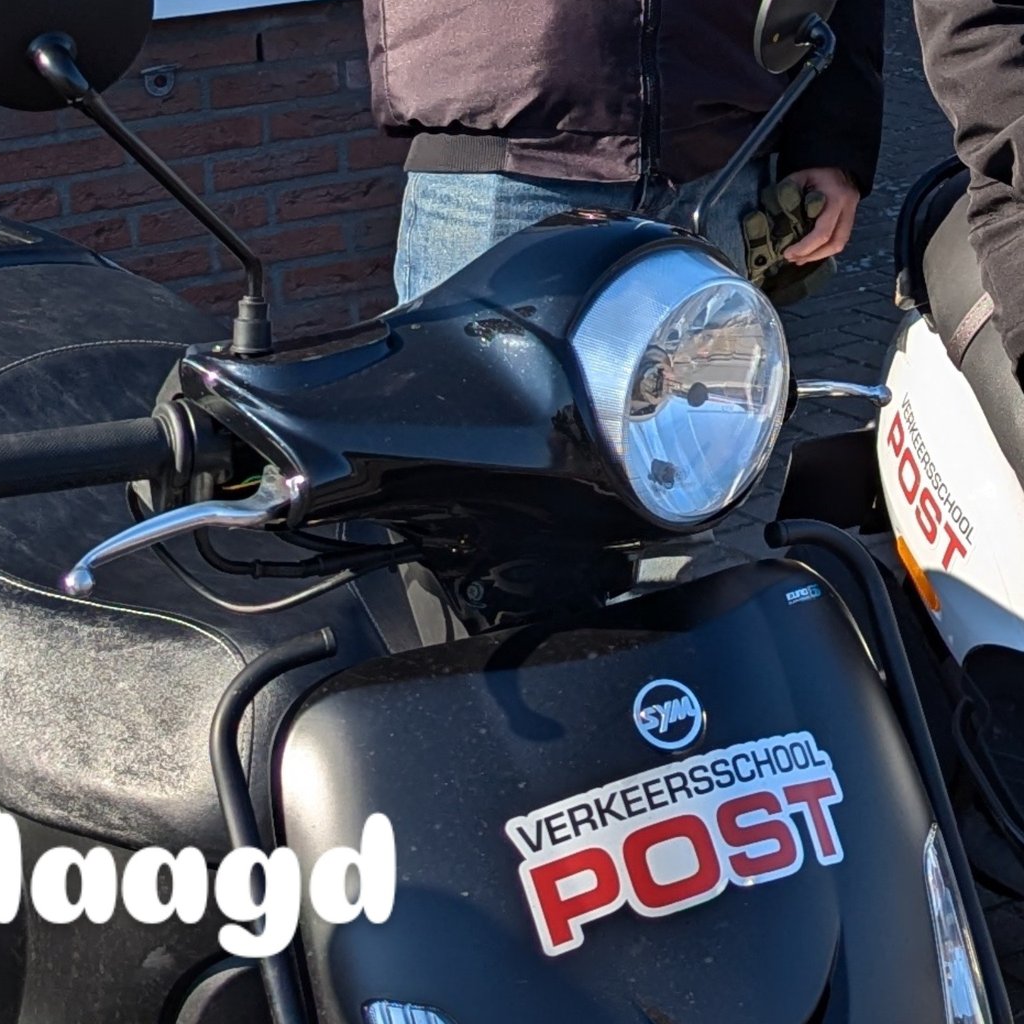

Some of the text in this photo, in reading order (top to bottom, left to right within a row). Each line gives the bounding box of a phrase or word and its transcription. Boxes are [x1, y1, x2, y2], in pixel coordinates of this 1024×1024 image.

[887, 410, 967, 570] POST
[901, 391, 974, 546] VERKEERSSCHOOL
[639, 696, 696, 733] SYM
[516, 740, 826, 853] VERKEERSSCHOOL
[530, 778, 836, 947] POST
